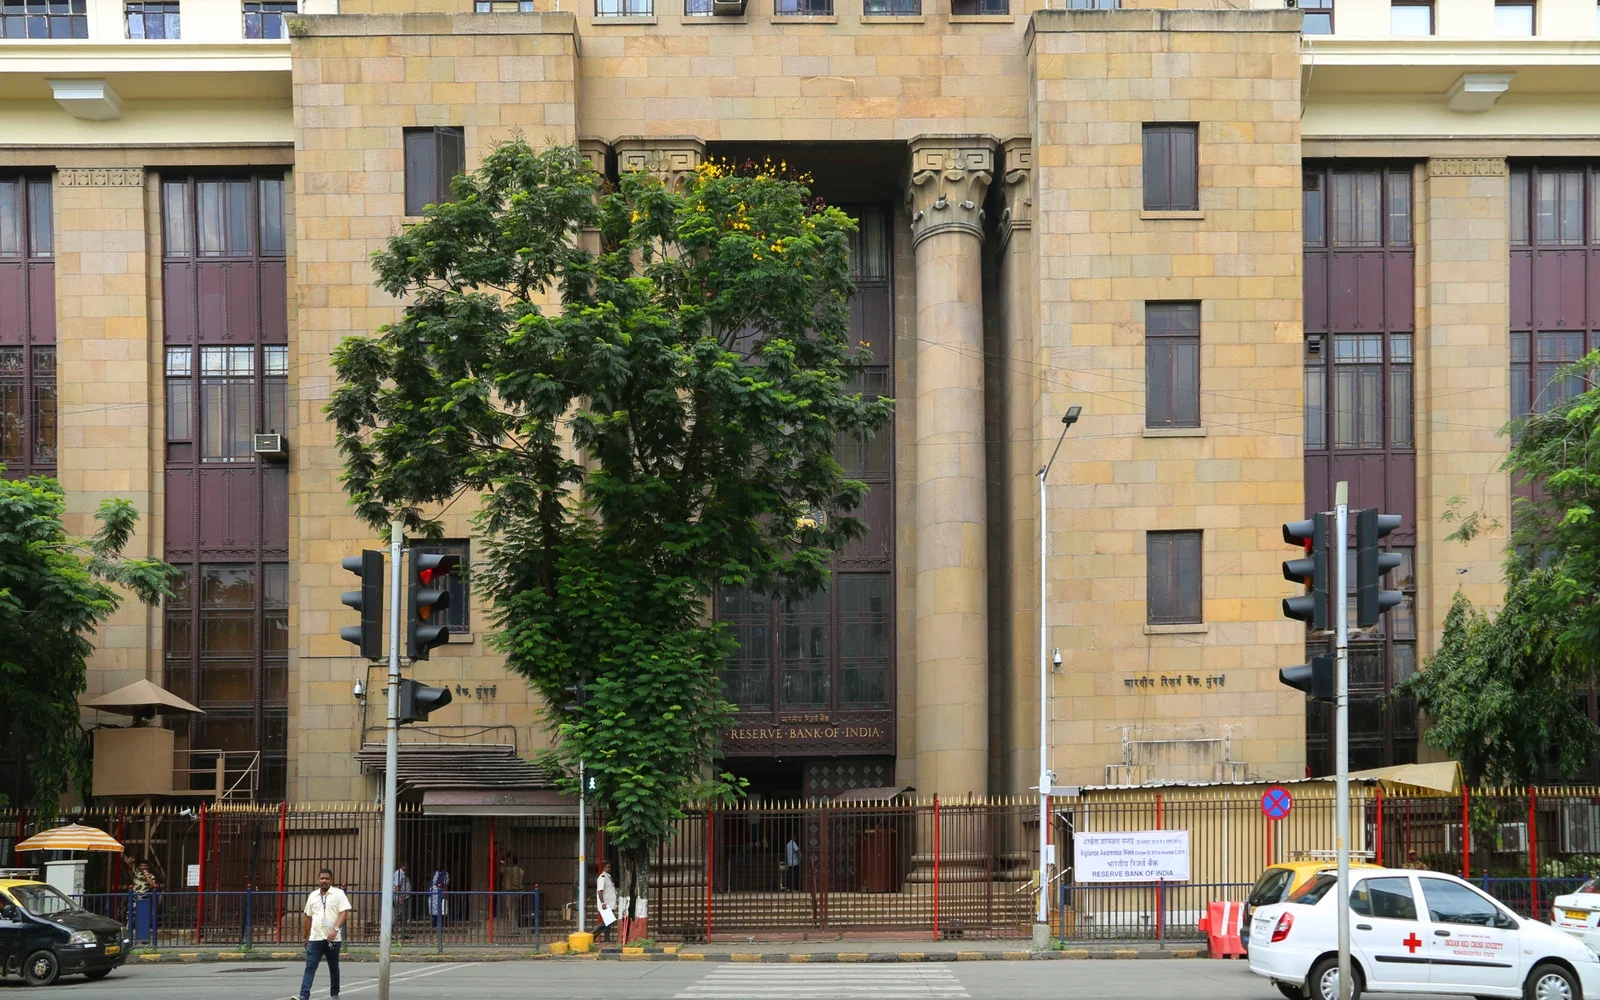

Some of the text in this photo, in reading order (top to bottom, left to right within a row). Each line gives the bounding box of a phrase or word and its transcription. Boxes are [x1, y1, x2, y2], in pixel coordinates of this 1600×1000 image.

[1124, 675, 1155, 688] भारतीय
[1206, 674, 1225, 689] मुंबई
[731, 727, 880, 739] RESERVE BANK OF INDIA
[1080, 849, 1099, 859] Vigilance
[1100, 849, 1122, 857] Awareness
[1123, 848, 1134, 856] Week
[1107, 859, 1128, 868] भारतीय
